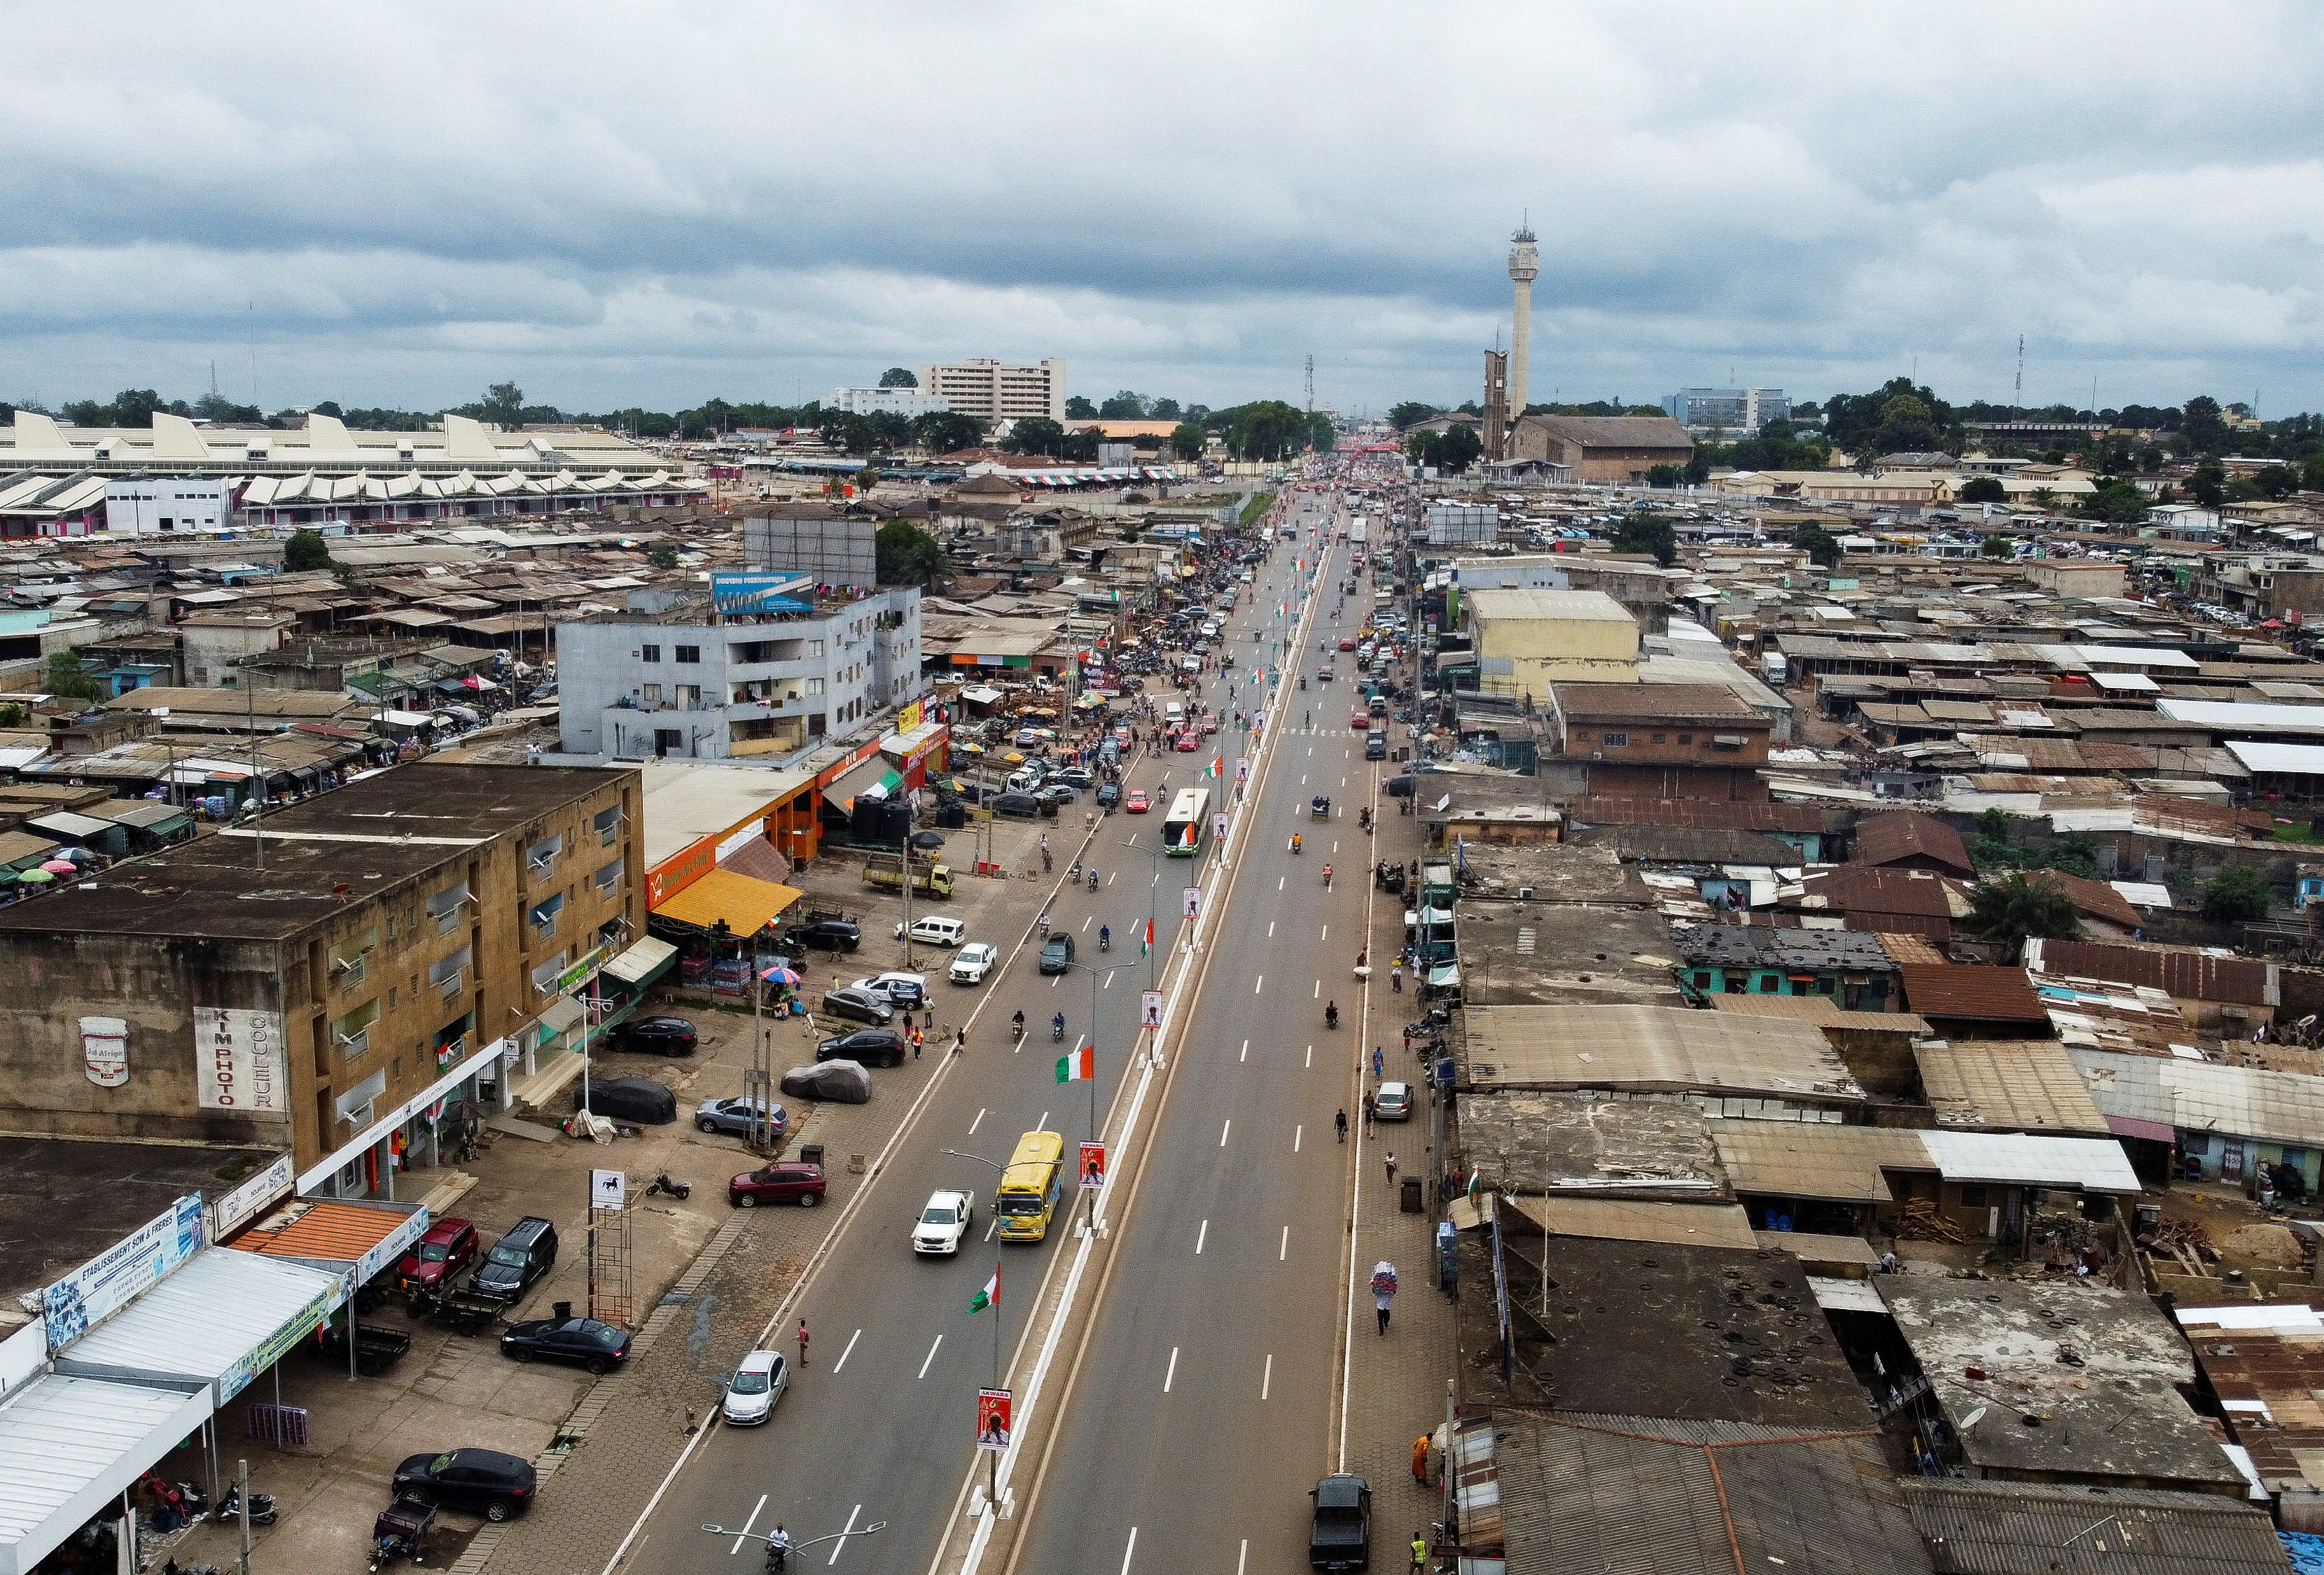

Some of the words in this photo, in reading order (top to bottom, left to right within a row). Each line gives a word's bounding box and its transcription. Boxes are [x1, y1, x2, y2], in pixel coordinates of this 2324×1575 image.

[215, 1049, 235, 1105] PHOTO
[250, 1016, 272, 1107] COULEUR
[81, 1242, 132, 1282] ETABLISSEMENT
[132, 1232, 146, 1250] SOW
[146, 1229, 151, 1240] &
[151, 1214, 173, 1236] FRERES
